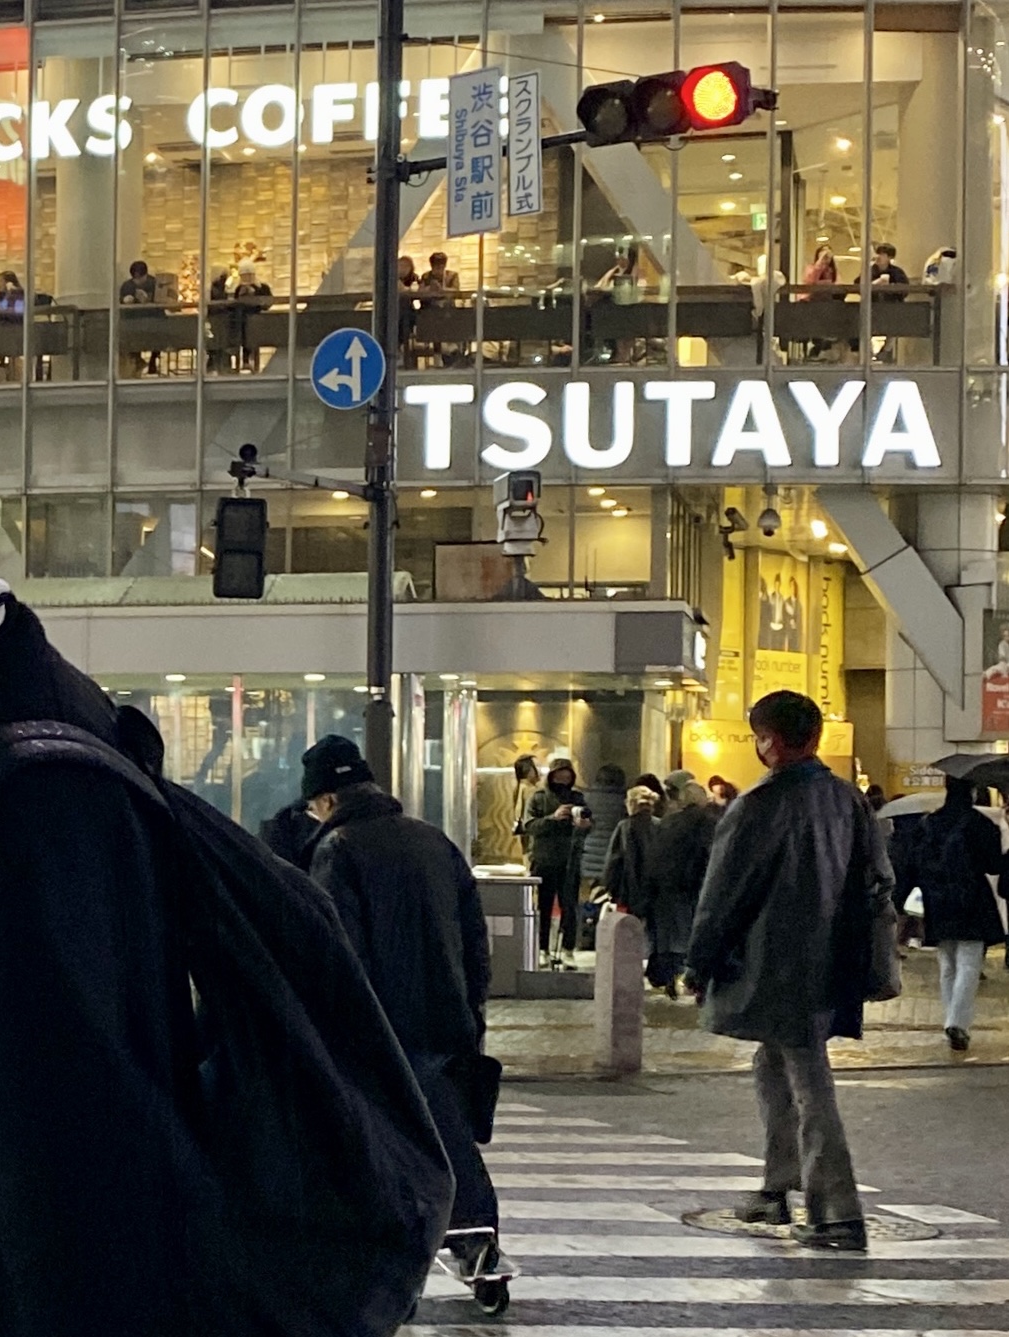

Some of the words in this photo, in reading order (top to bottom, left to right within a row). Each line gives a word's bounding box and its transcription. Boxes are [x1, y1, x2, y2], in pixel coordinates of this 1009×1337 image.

[186, 76, 510, 148] COFFE
[453, 108, 469, 172] Shibuya
[514, 79, 535, 212] スクランブル式
[470, 82, 495, 222] 渋谷駅前
[453, 176, 468, 208] Sta.
[405, 380, 942, 470] TSUTAYA
[819, 644, 832, 717] numb
